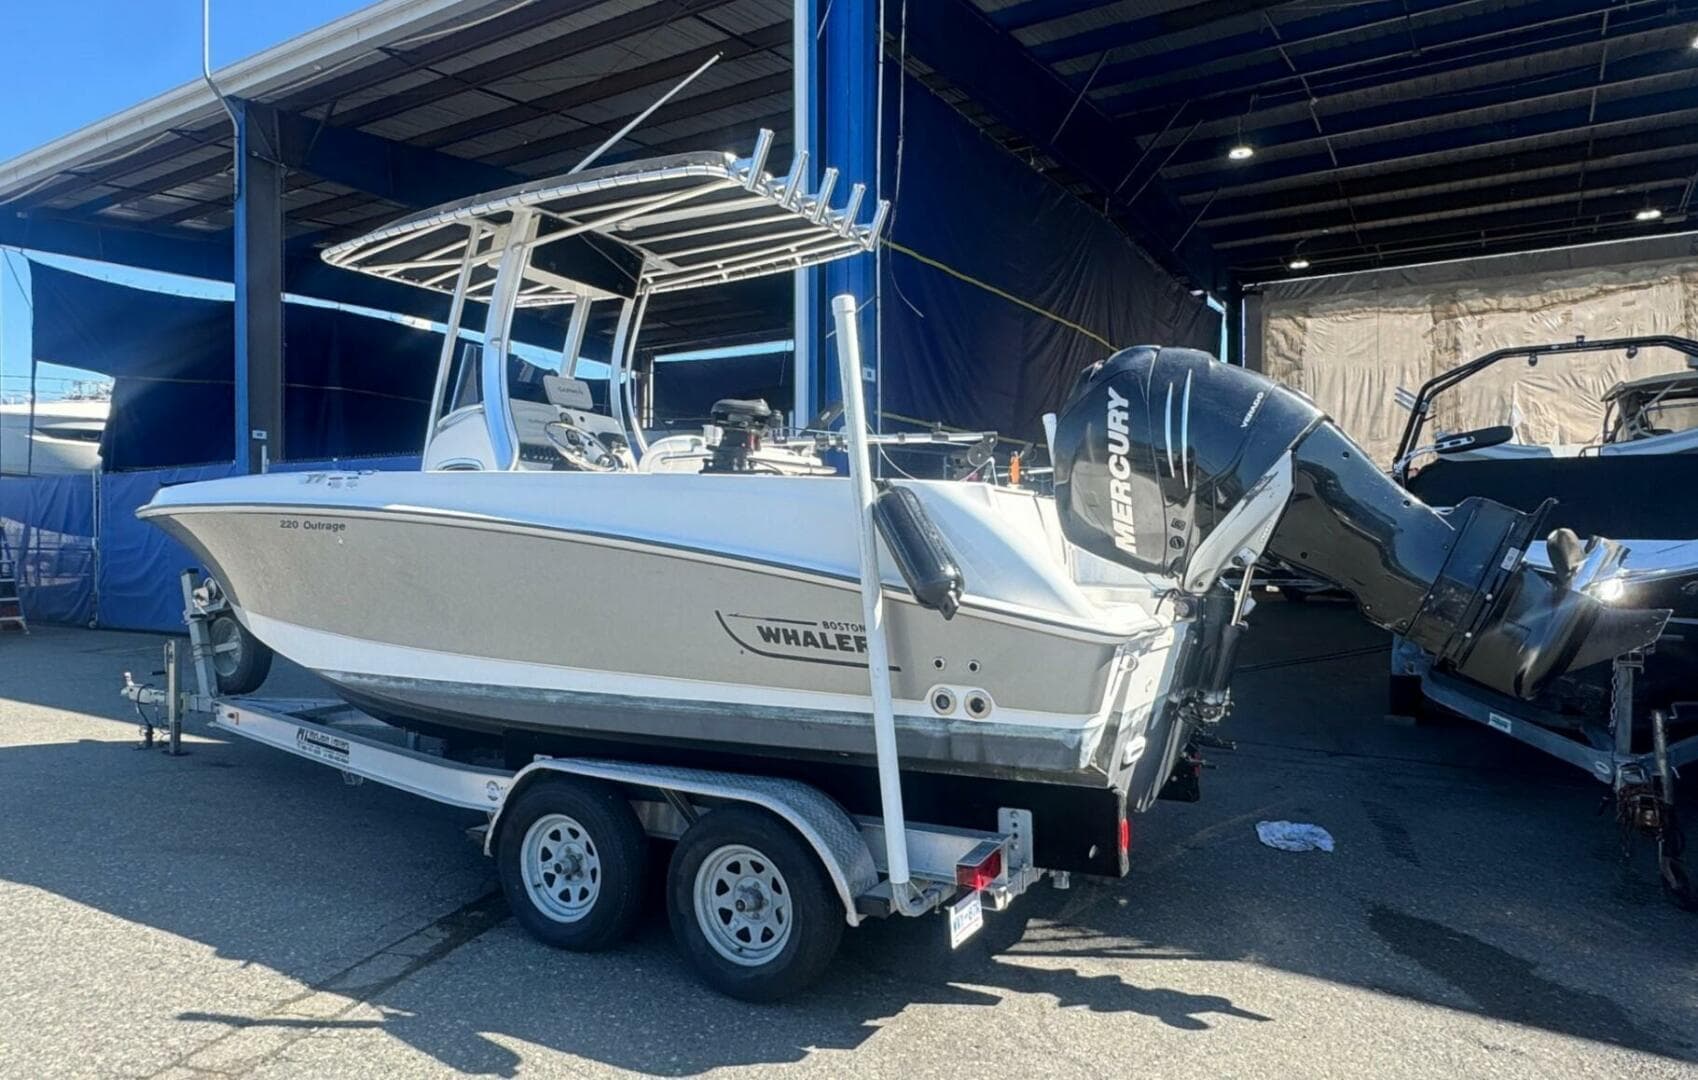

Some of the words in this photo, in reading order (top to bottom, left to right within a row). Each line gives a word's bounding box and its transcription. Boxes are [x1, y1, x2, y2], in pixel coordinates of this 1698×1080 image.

[1107, 386, 1137, 554] MERCURY
[280, 520, 299, 529] 220
[303, 521, 346, 532] Outrage
[822, 620, 866, 632] BOSTON
